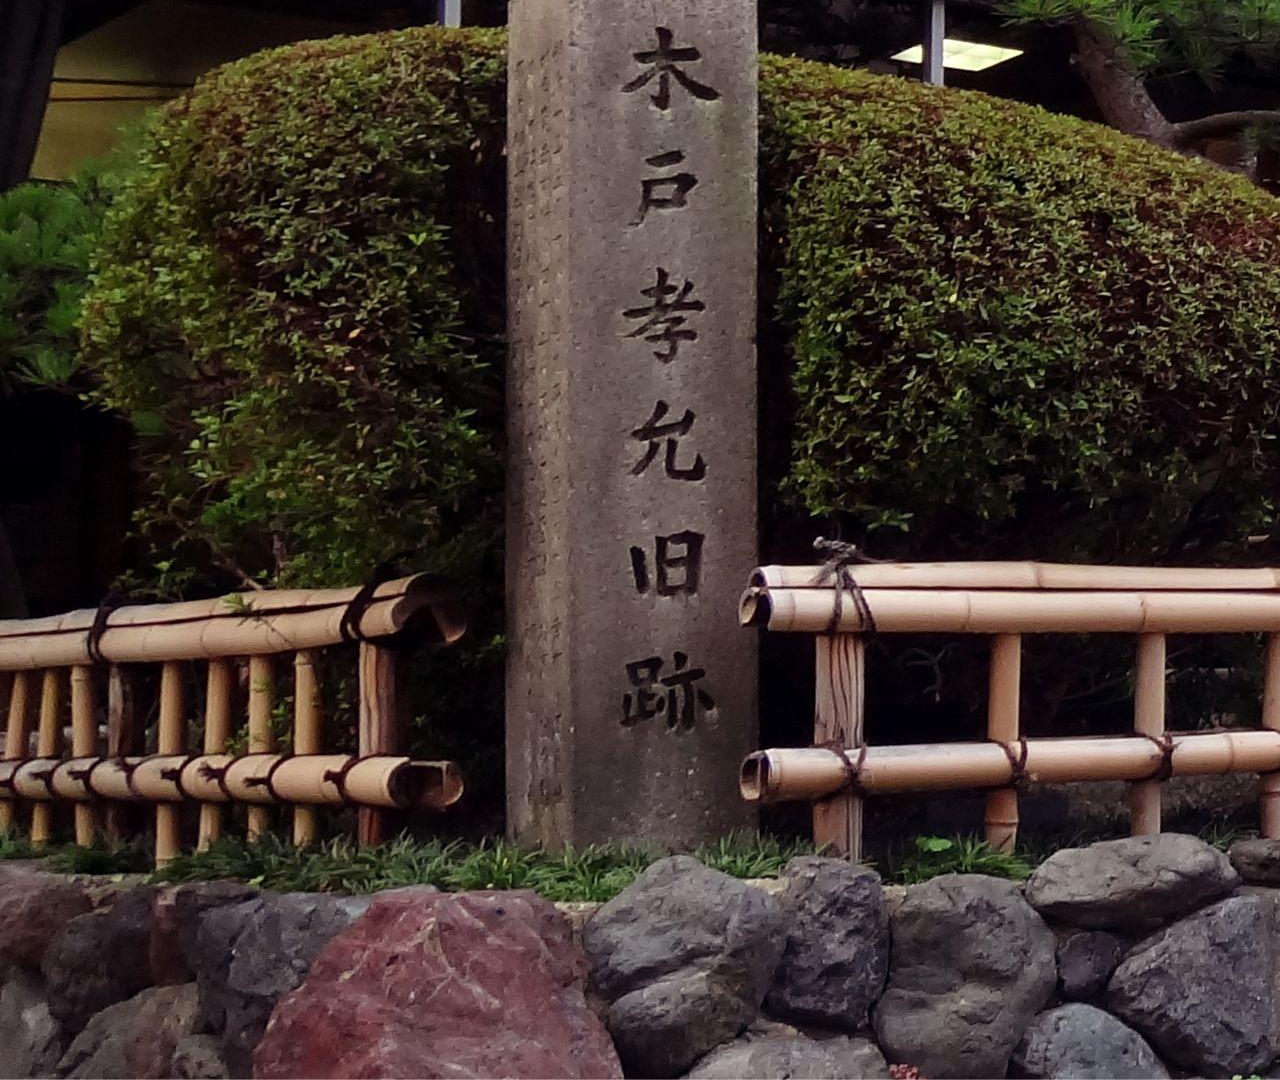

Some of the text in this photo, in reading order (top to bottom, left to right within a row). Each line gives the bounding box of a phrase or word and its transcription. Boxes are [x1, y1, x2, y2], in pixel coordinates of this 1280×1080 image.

[620, 25, 722, 731] 木戸孝允旧跡
